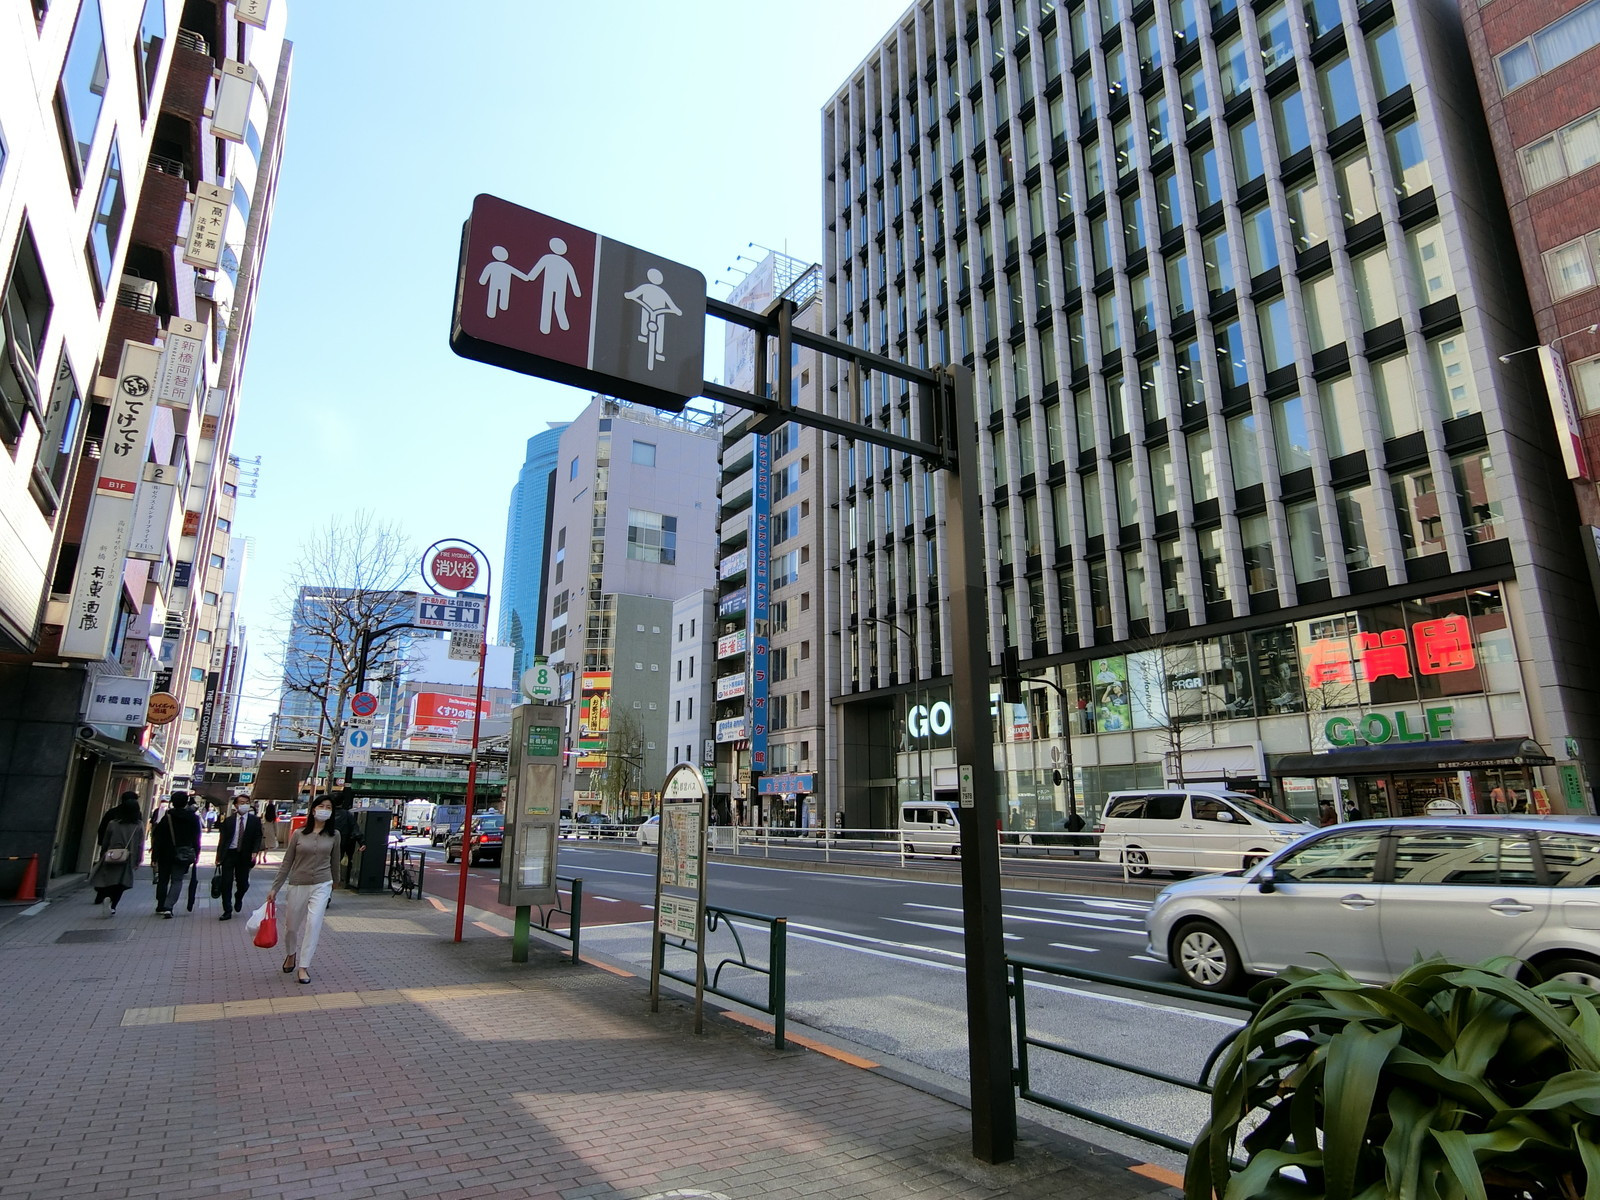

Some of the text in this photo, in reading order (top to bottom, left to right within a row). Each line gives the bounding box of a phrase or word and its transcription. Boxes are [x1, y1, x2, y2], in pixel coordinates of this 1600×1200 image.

[236, 66, 244, 75] 5
[191, 216, 207, 256] 法律事務所
[183, 324, 193, 333] 3
[171, 340, 196, 400] 新橋両替所
[113, 400, 144, 457] てけてけ
[154, 468, 164, 478] 2
[435, 559, 476, 579] 消火栓
[757, 513, 767, 611] KARAOKE KAN
[422, 597, 480, 608] 不動産は信頼の
[425, 605, 475, 622] KEN
[447, 621, 479, 629] 5159-8655
[719, 640, 736, 655] 麻雀
[1301, 615, 1476, 688] 有賀園
[537, 669, 548, 684] 8
[1172, 677, 1202, 690] PRGR
[95, 694, 143, 706] 新橋眼科
[754, 644, 767, 763] カラオケ館
[203, 702, 213, 715] SUIT
[200, 714, 210, 744] COMPANY
[1325, 706, 1453, 746] GOLF
